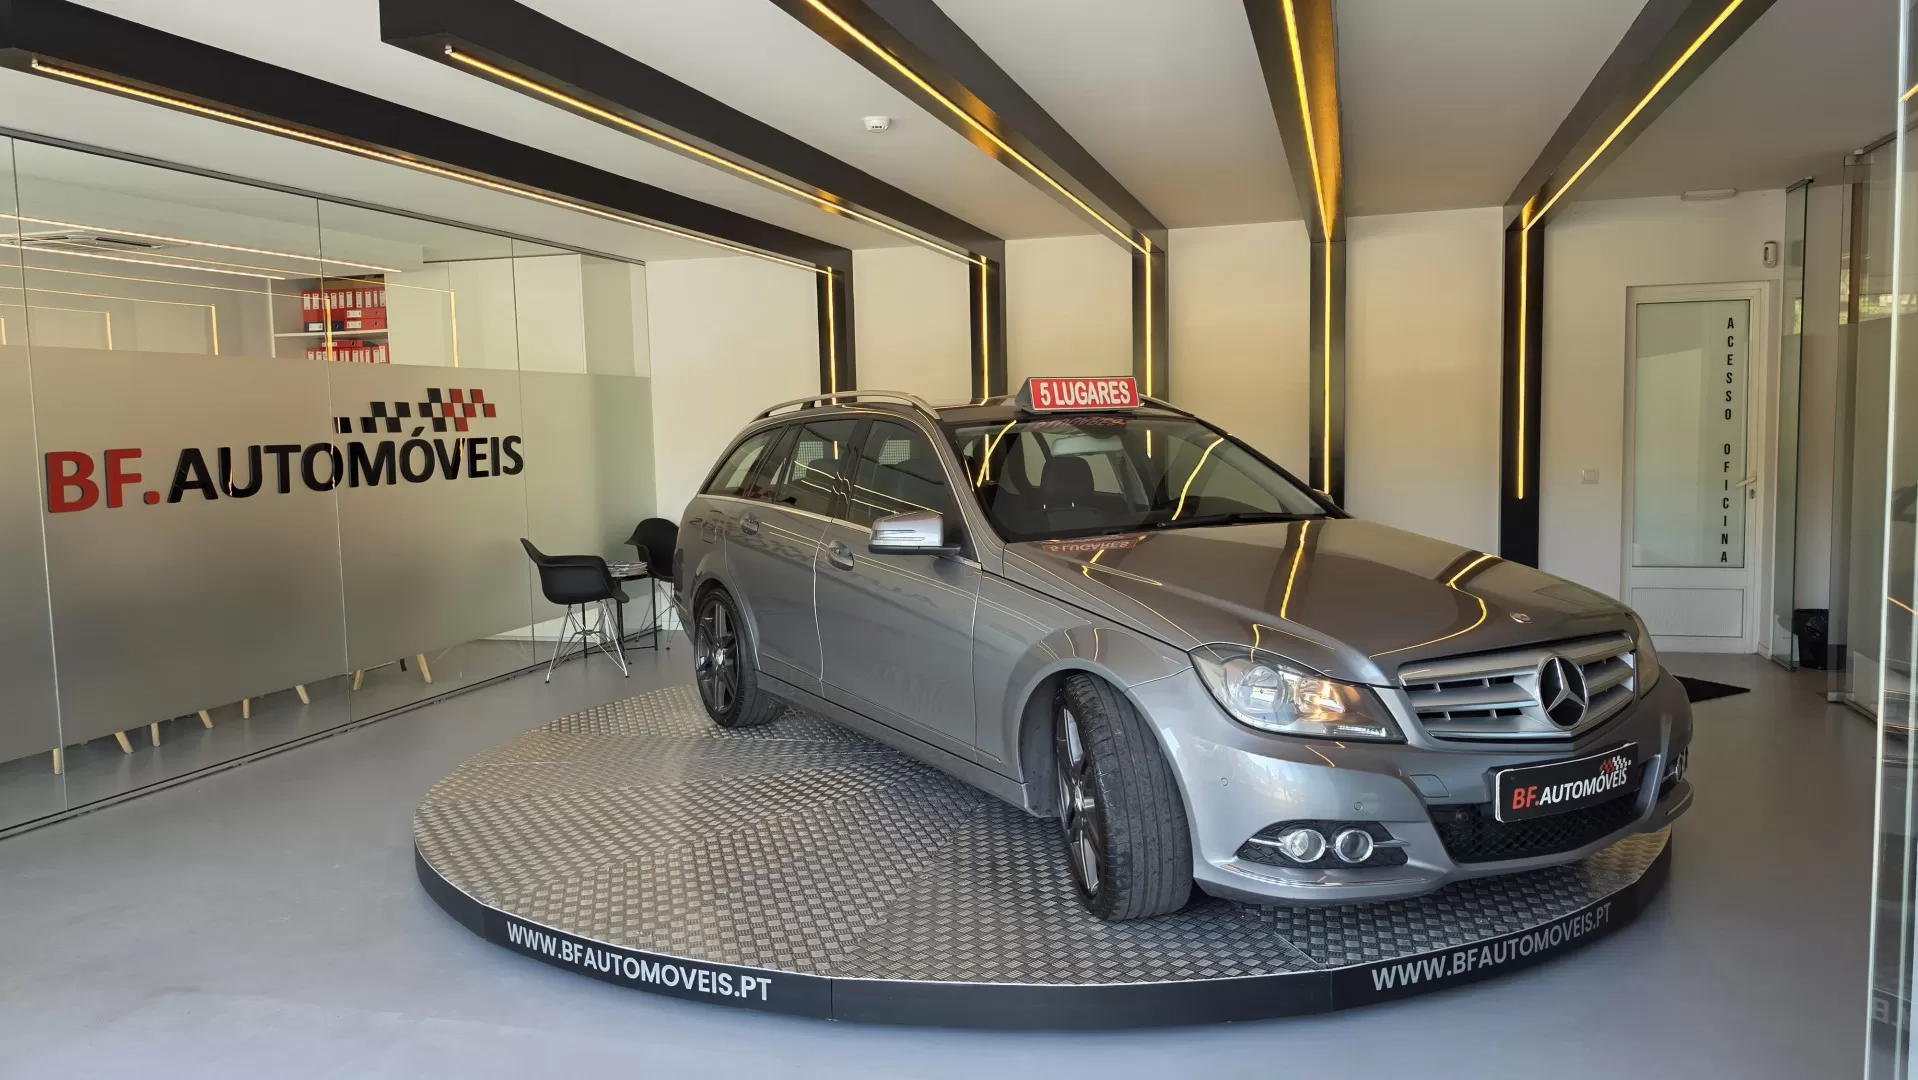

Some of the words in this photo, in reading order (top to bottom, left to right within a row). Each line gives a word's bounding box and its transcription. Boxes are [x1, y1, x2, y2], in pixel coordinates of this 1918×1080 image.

[1040, 382, 1051, 406] 5
[1053, 381, 1131, 406] LUGARES
[1724, 317, 1734, 420] ACESSO
[1720, 443, 1730, 563] OFICINA
[506, 921, 772, 1001] WWW.BFAUTOMOVEIS.PT
[1371, 902, 1612, 991] WWW.BFAUTOMOVEIS.PT
